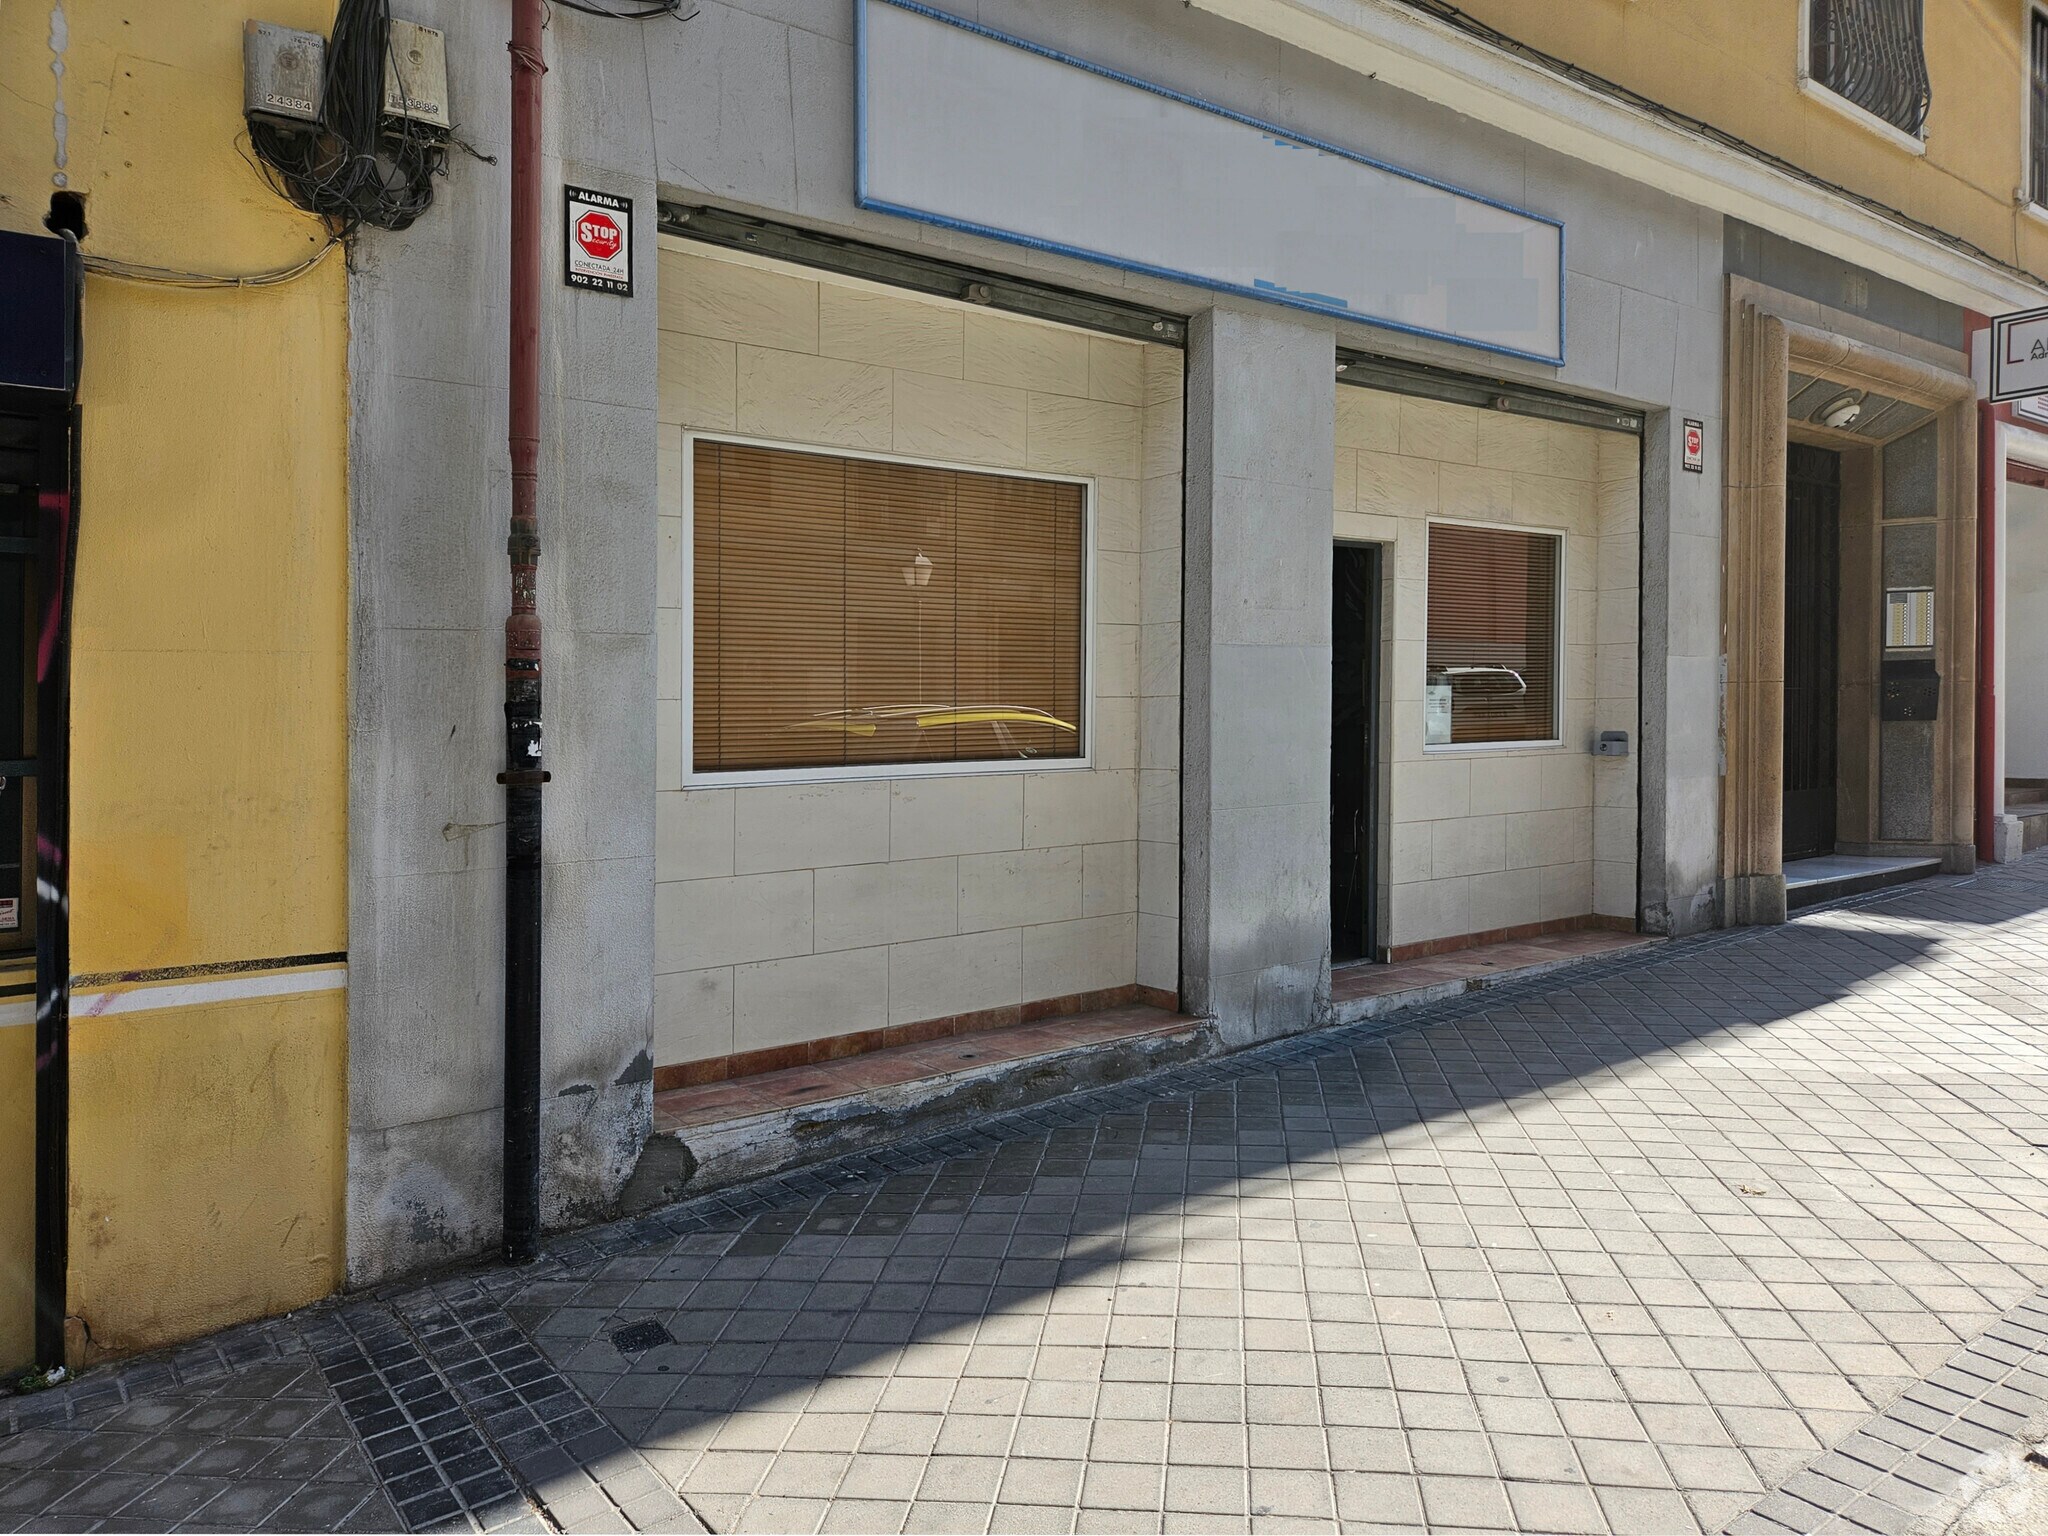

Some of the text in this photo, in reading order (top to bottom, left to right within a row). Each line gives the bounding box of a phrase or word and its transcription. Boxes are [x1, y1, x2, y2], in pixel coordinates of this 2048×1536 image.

[266, 93, 312, 112] 24384
[578, 191, 619, 208] ALARMA
[580, 222, 618, 242] STOP
[574, 260, 611, 271] CONECTADA
[570, 274, 628, 292] 902 22 11 02
